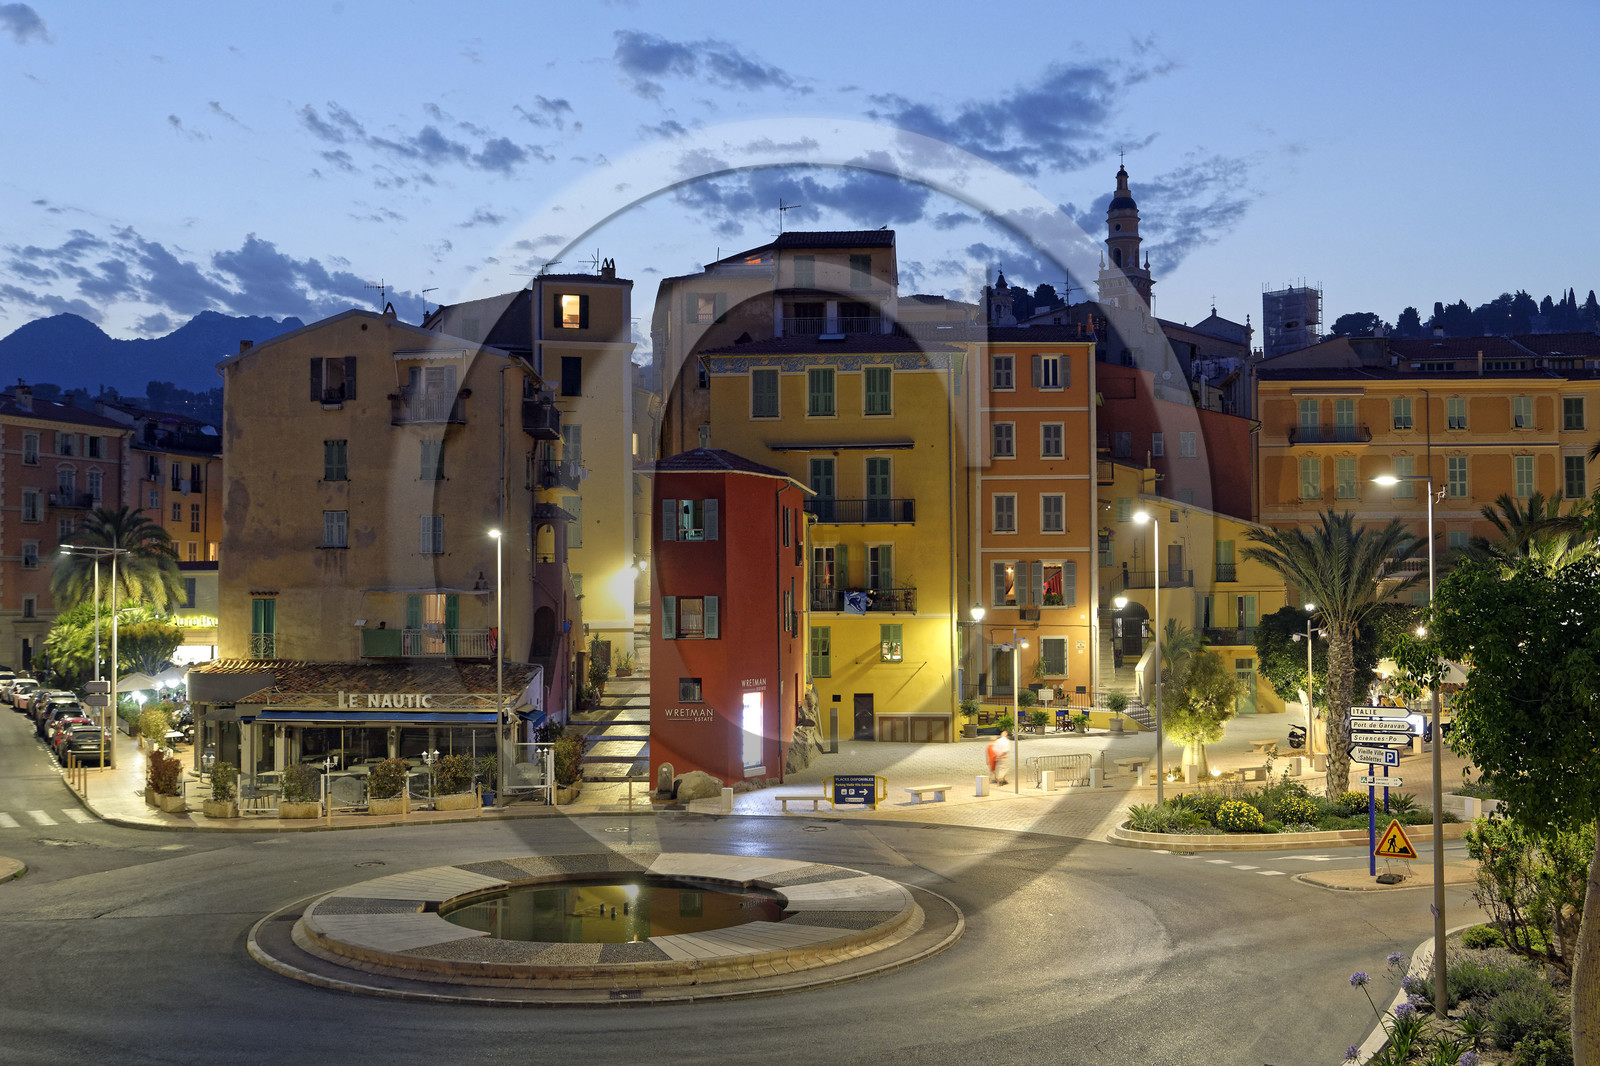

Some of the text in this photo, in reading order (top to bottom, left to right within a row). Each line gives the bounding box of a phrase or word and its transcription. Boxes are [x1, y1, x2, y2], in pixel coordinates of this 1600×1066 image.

[741, 678, 767, 687] WRETMAN
[338, 690, 432, 708] LE NAUTIC
[665, 708, 714, 717] WRETMAN
